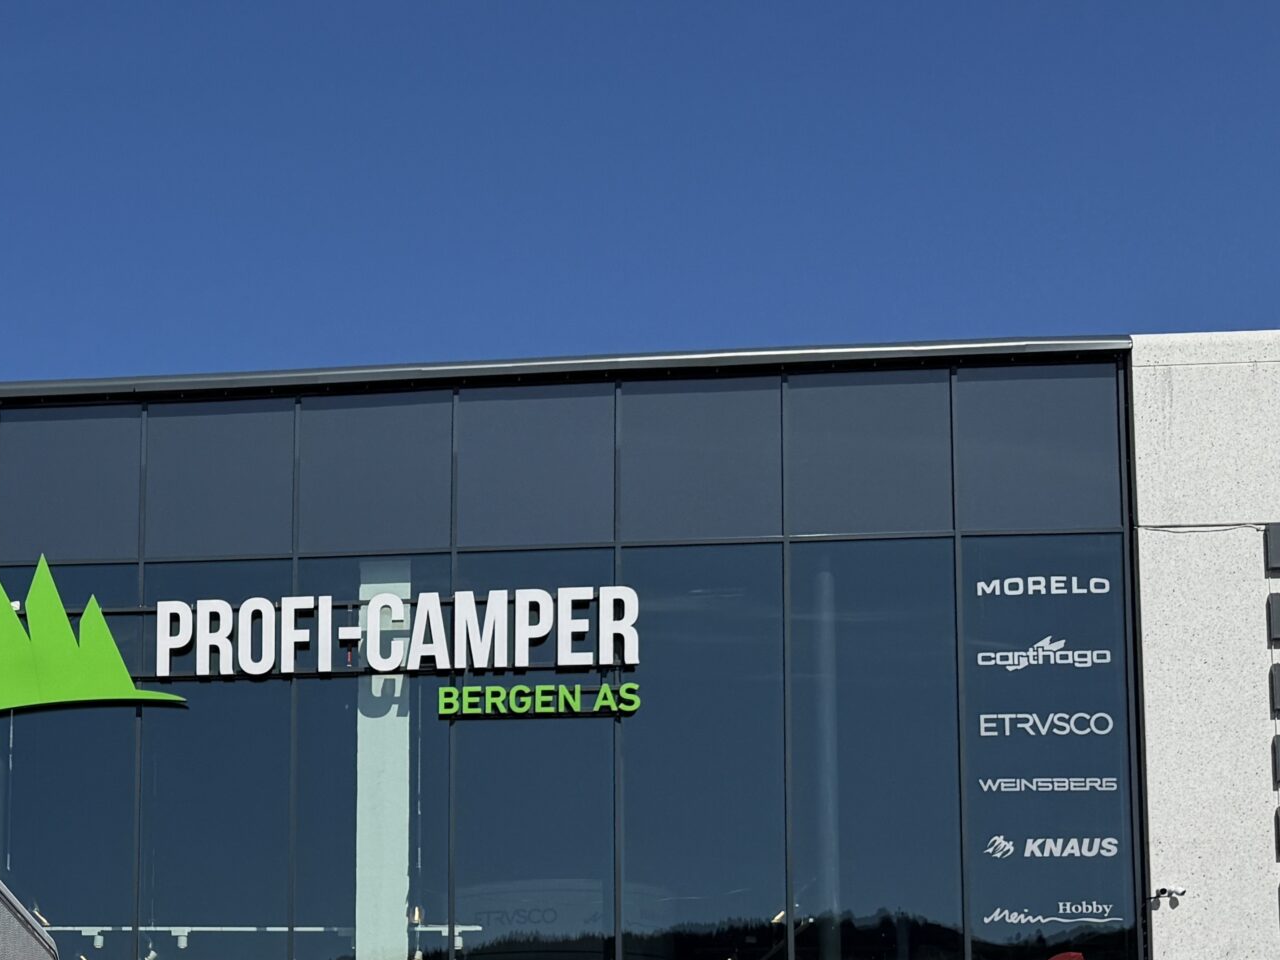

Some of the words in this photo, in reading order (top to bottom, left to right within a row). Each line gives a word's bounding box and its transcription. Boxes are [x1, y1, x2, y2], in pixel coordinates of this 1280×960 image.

[977, 576, 1110, 596] MORELO
[156, 585, 640, 678] PROFI-CAMPER
[977, 644, 1111, 668] carthago
[437, 686, 580, 716] BERGEN
[593, 682, 641, 713] AS
[978, 777, 1118, 792] WEINSBERG
[1024, 837, 1118, 857] KNAUS
[1058, 901, 1113, 917] Hobby
